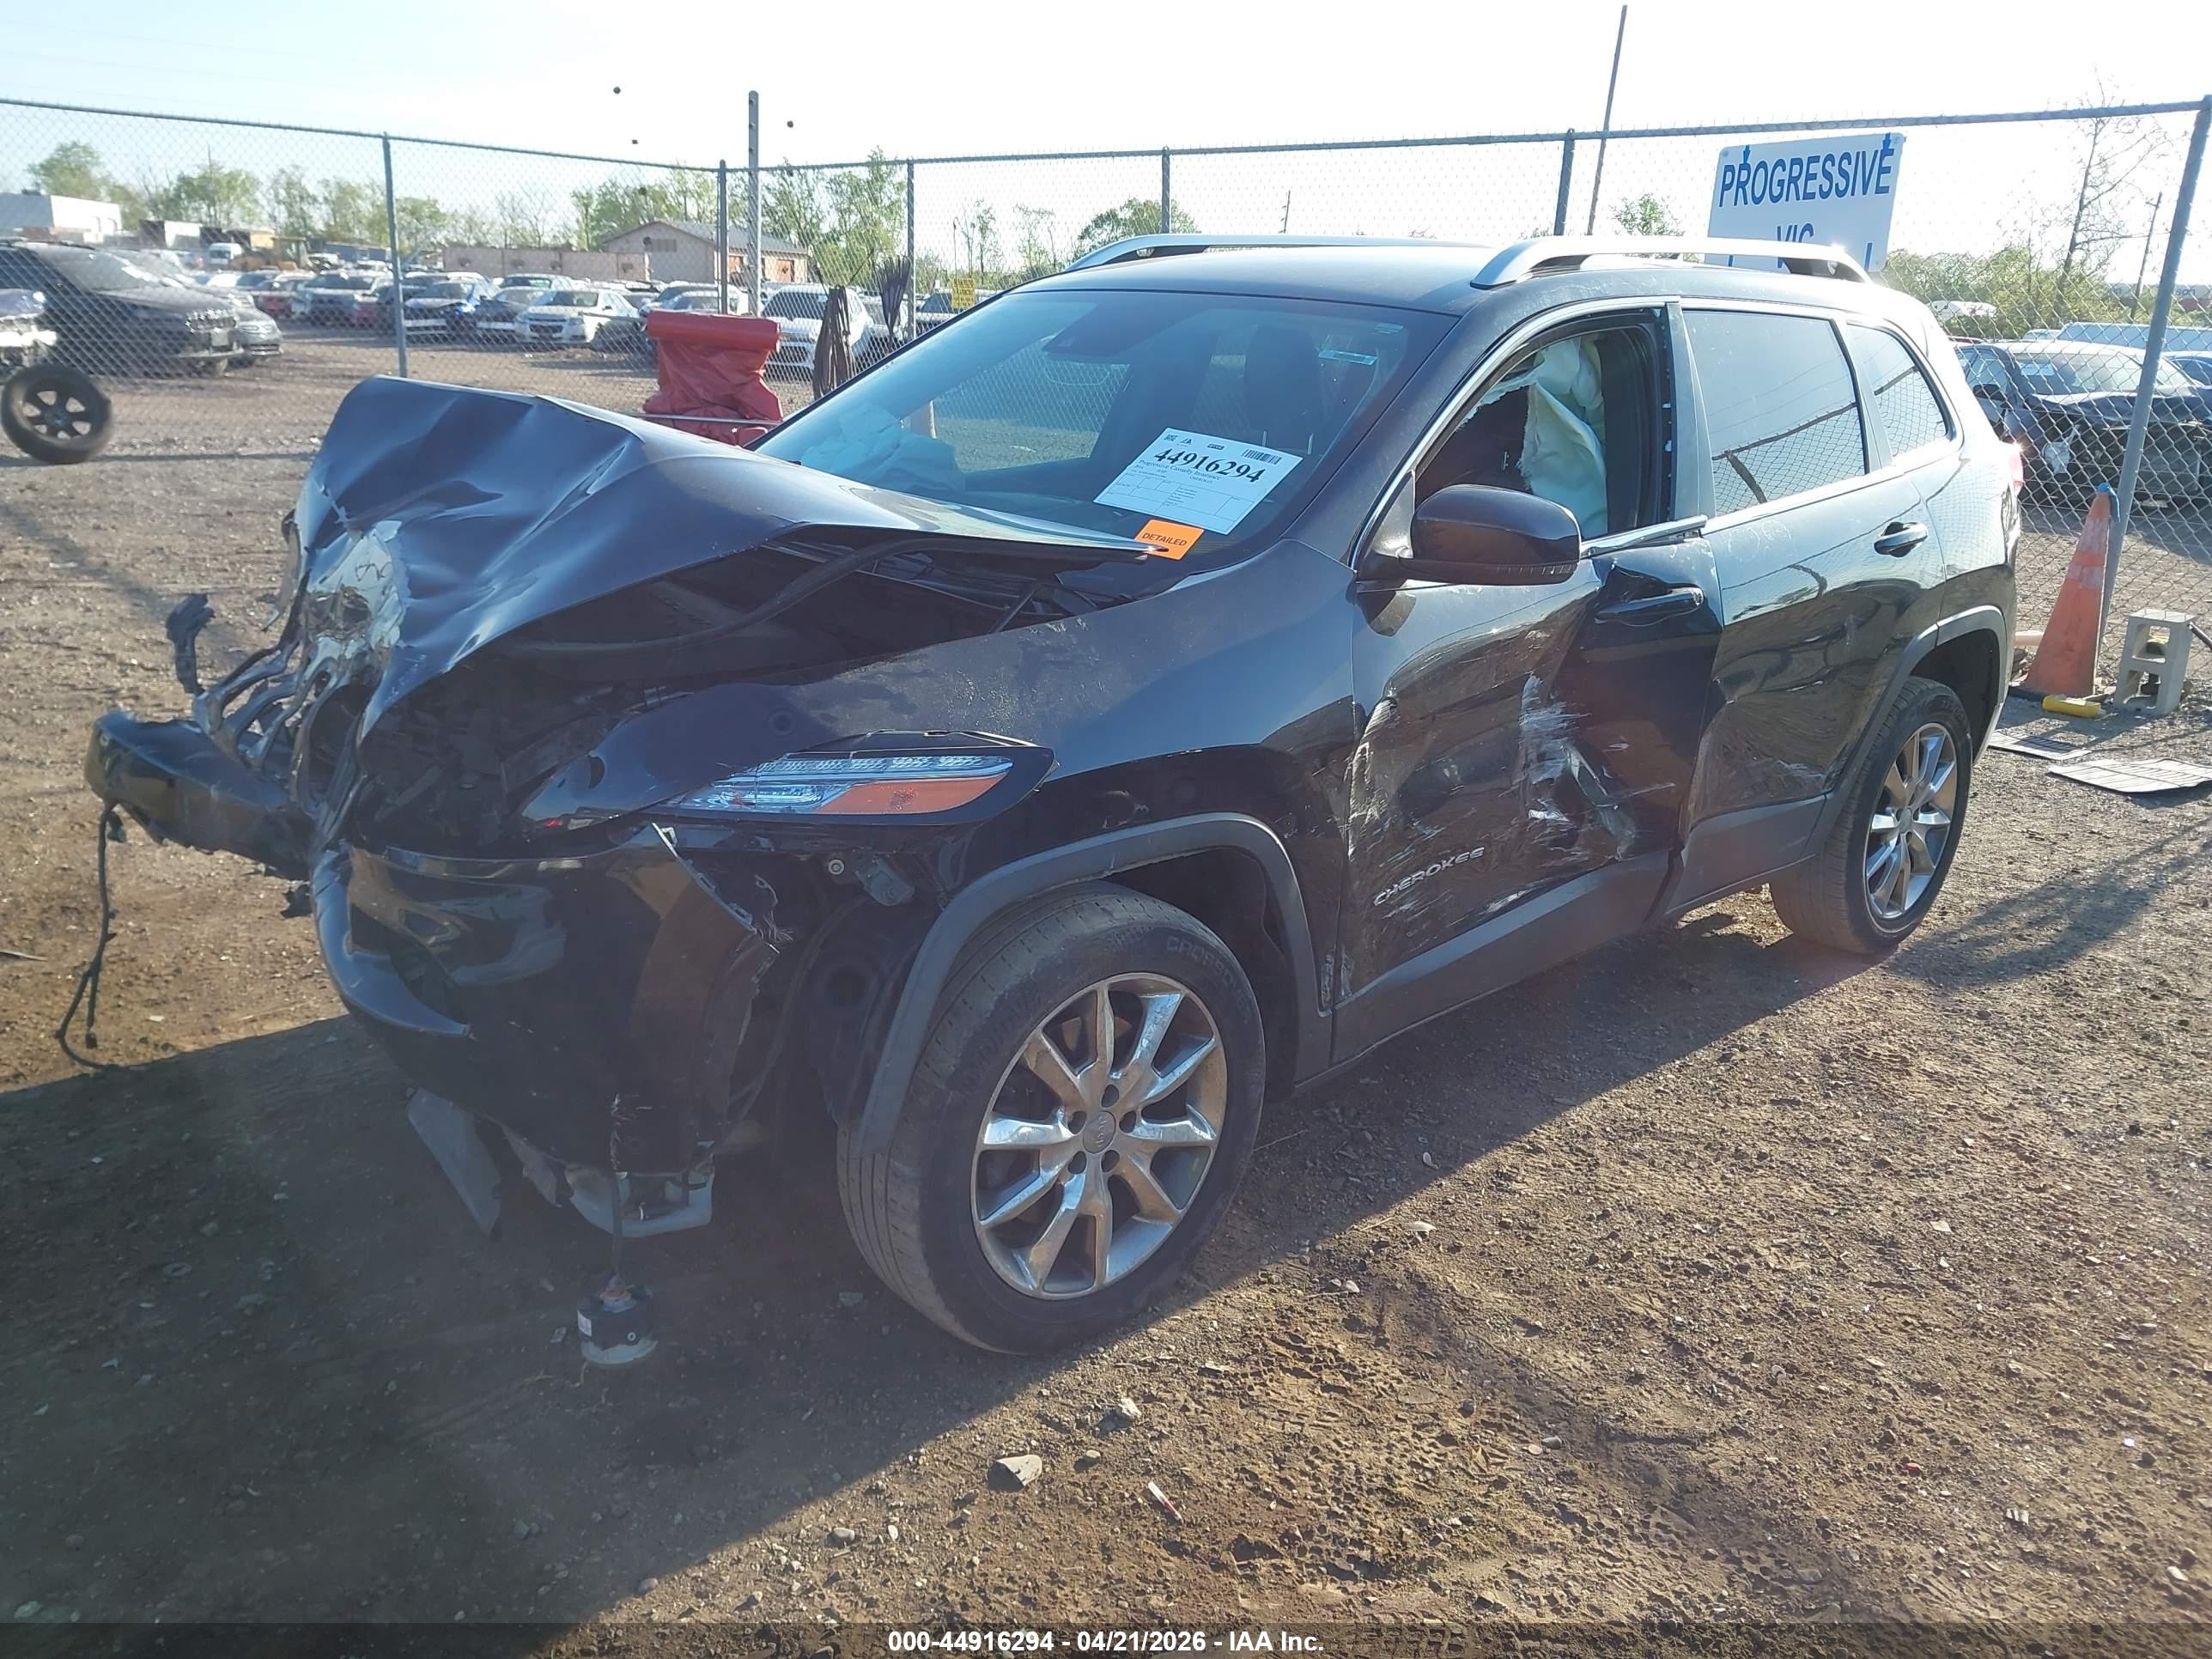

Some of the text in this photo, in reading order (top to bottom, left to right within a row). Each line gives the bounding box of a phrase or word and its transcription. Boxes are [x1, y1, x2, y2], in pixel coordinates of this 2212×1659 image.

[1718, 148, 1895, 208] PROGRESSIVE
[1154, 447, 1267, 483] 44916294
[1140, 532, 1188, 547] DETAILED
[1373, 847, 1485, 907] CHEROKEE
